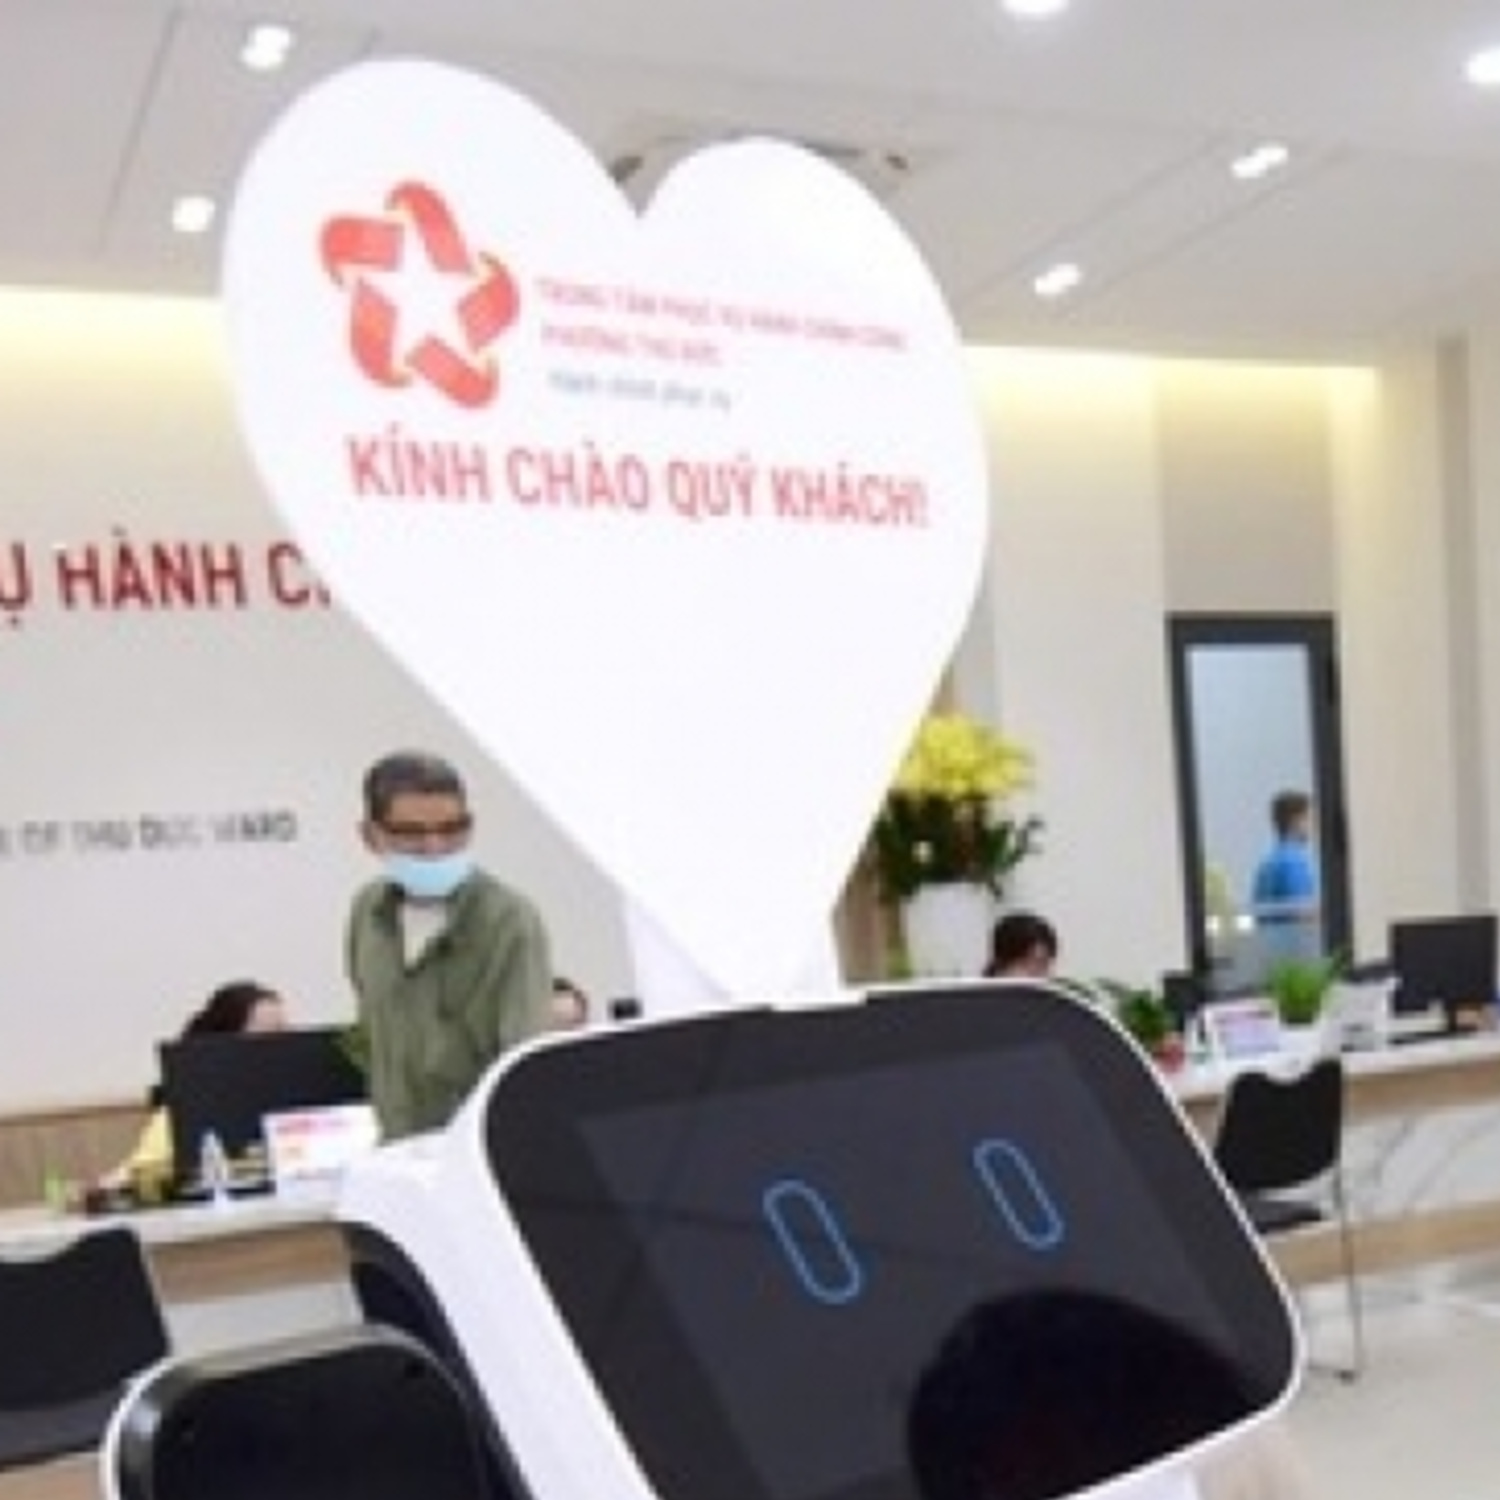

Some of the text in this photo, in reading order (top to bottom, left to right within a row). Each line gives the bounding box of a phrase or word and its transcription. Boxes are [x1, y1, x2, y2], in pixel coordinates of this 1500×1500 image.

[344, 420, 931, 528] KÍNH CHÀO QUÝ KHÁCH!
[56, 526, 248, 611] HÀNH
[267, 540, 332, 610] C
